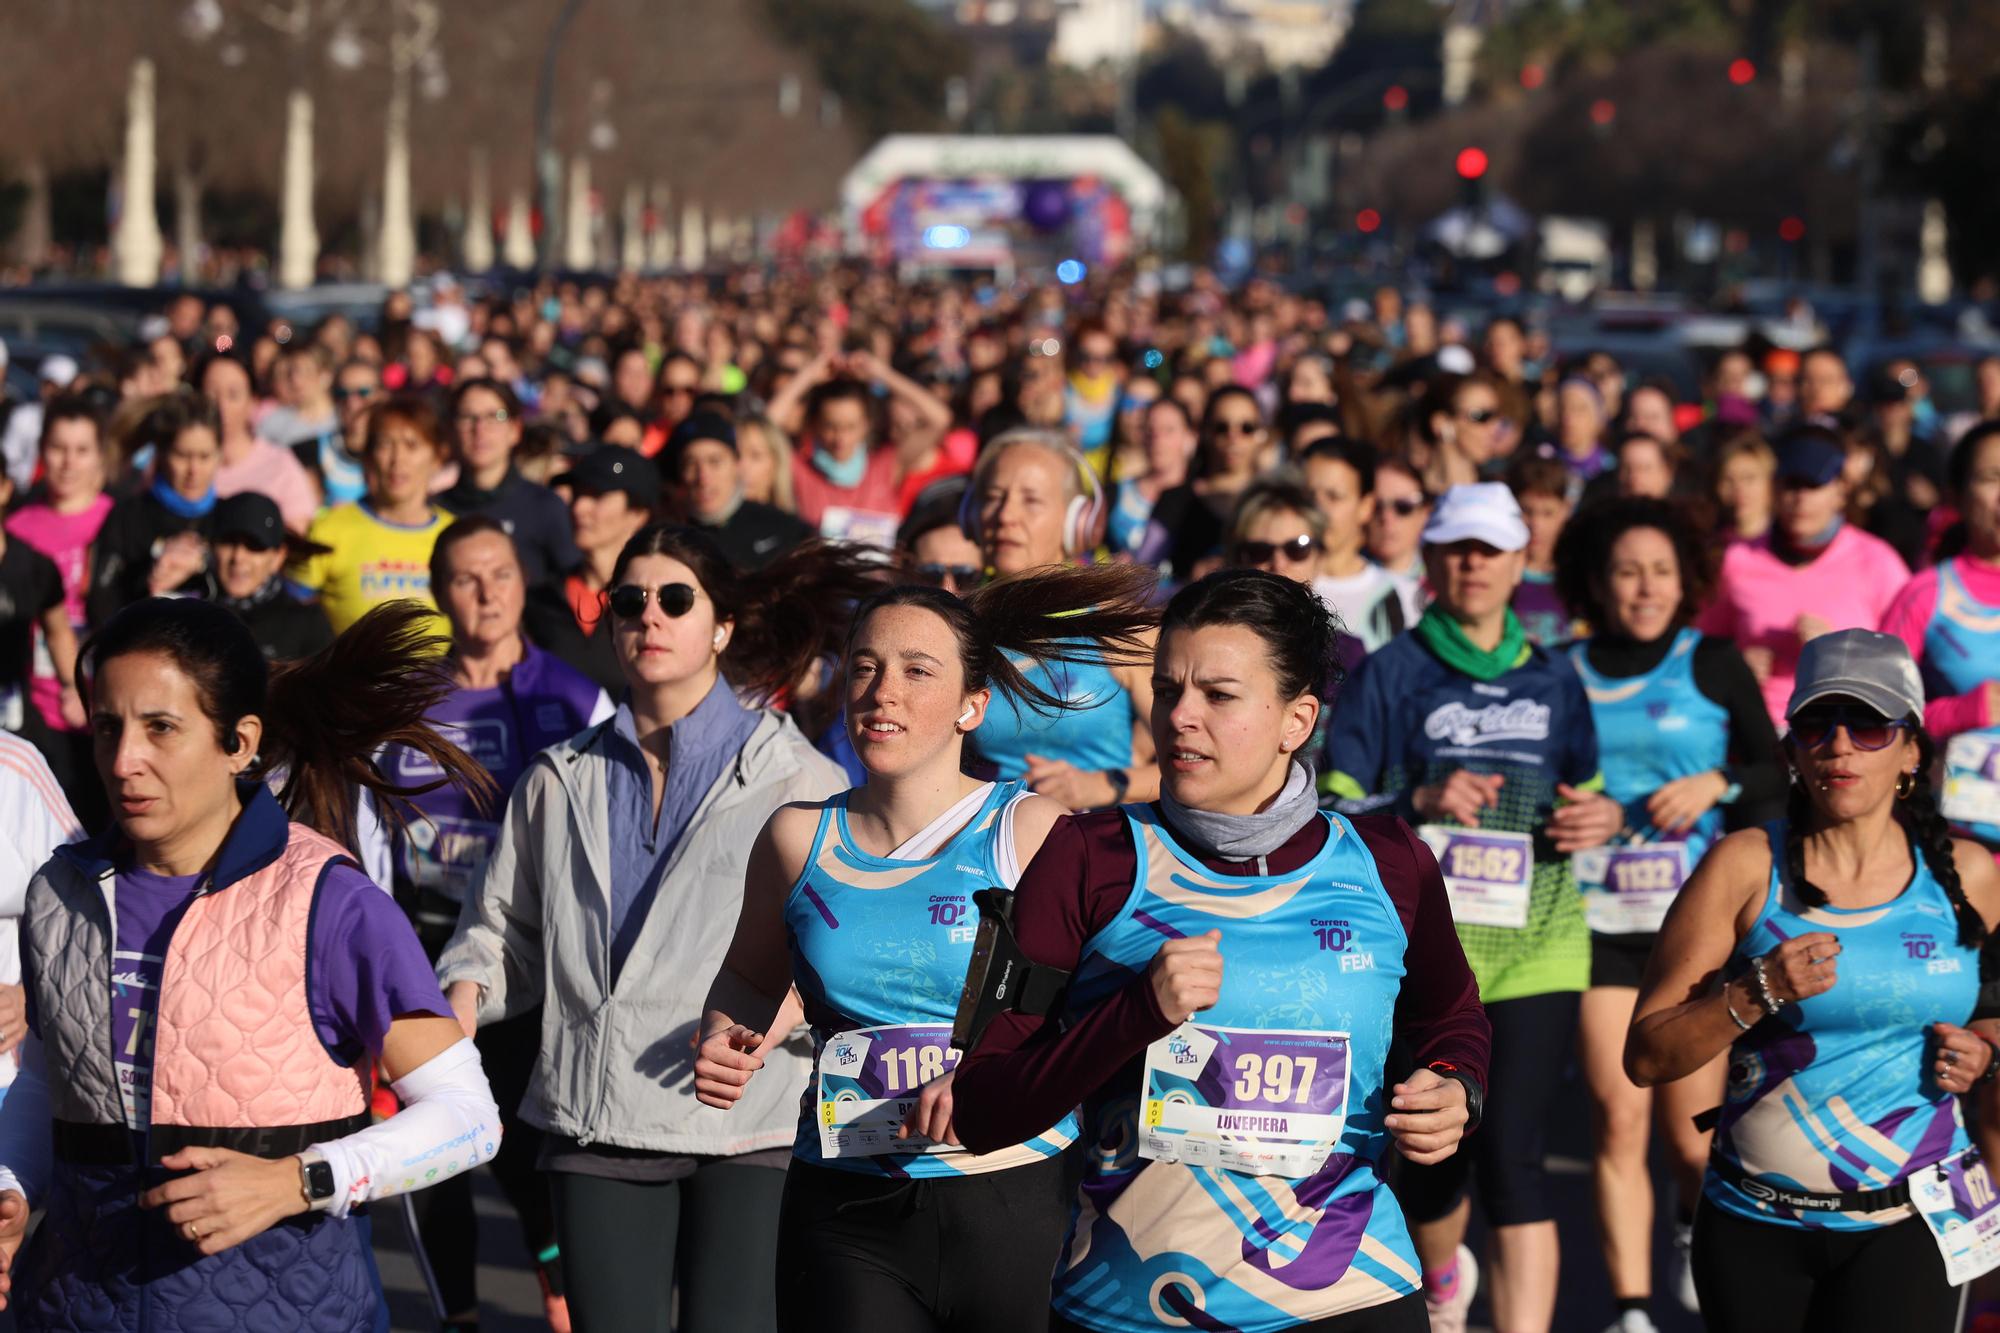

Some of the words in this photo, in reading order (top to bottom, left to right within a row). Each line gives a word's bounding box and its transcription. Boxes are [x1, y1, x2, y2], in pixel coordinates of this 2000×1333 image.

[1450, 844, 1521, 882] 1562
[1614, 858, 1674, 892] 1132
[1310, 919, 1349, 927] Carrera
[1341, 953, 1374, 973] FEM
[1235, 1053, 1318, 1104] 397
[1217, 1115, 1288, 1133] LUVEPIERA
[1779, 1193, 1841, 1211] Kalenji
